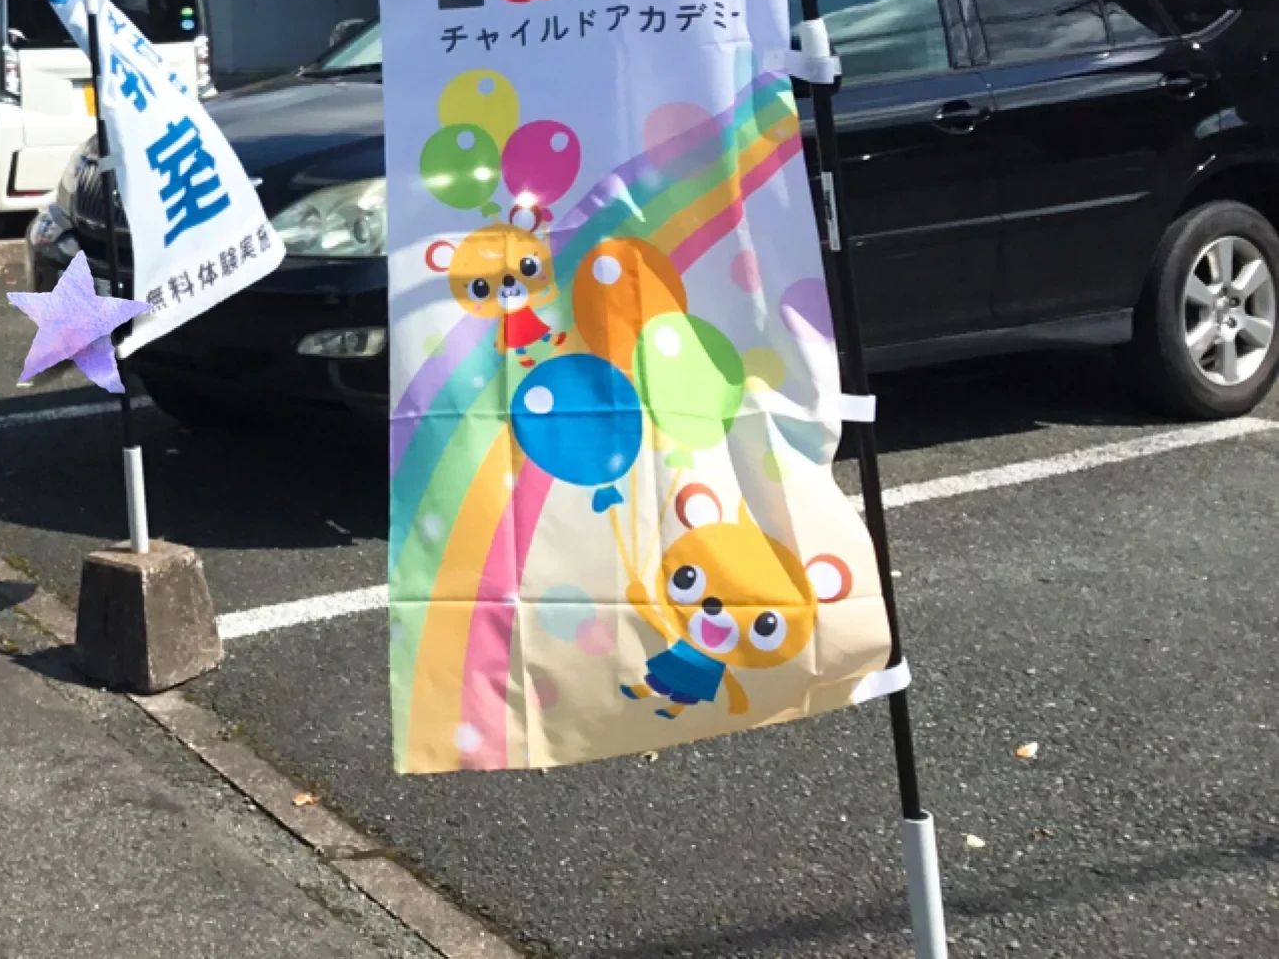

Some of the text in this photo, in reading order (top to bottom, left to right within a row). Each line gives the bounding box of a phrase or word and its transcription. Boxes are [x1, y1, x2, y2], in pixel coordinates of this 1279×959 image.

[440, 1, 740, 53] チャイルドアカデミー
